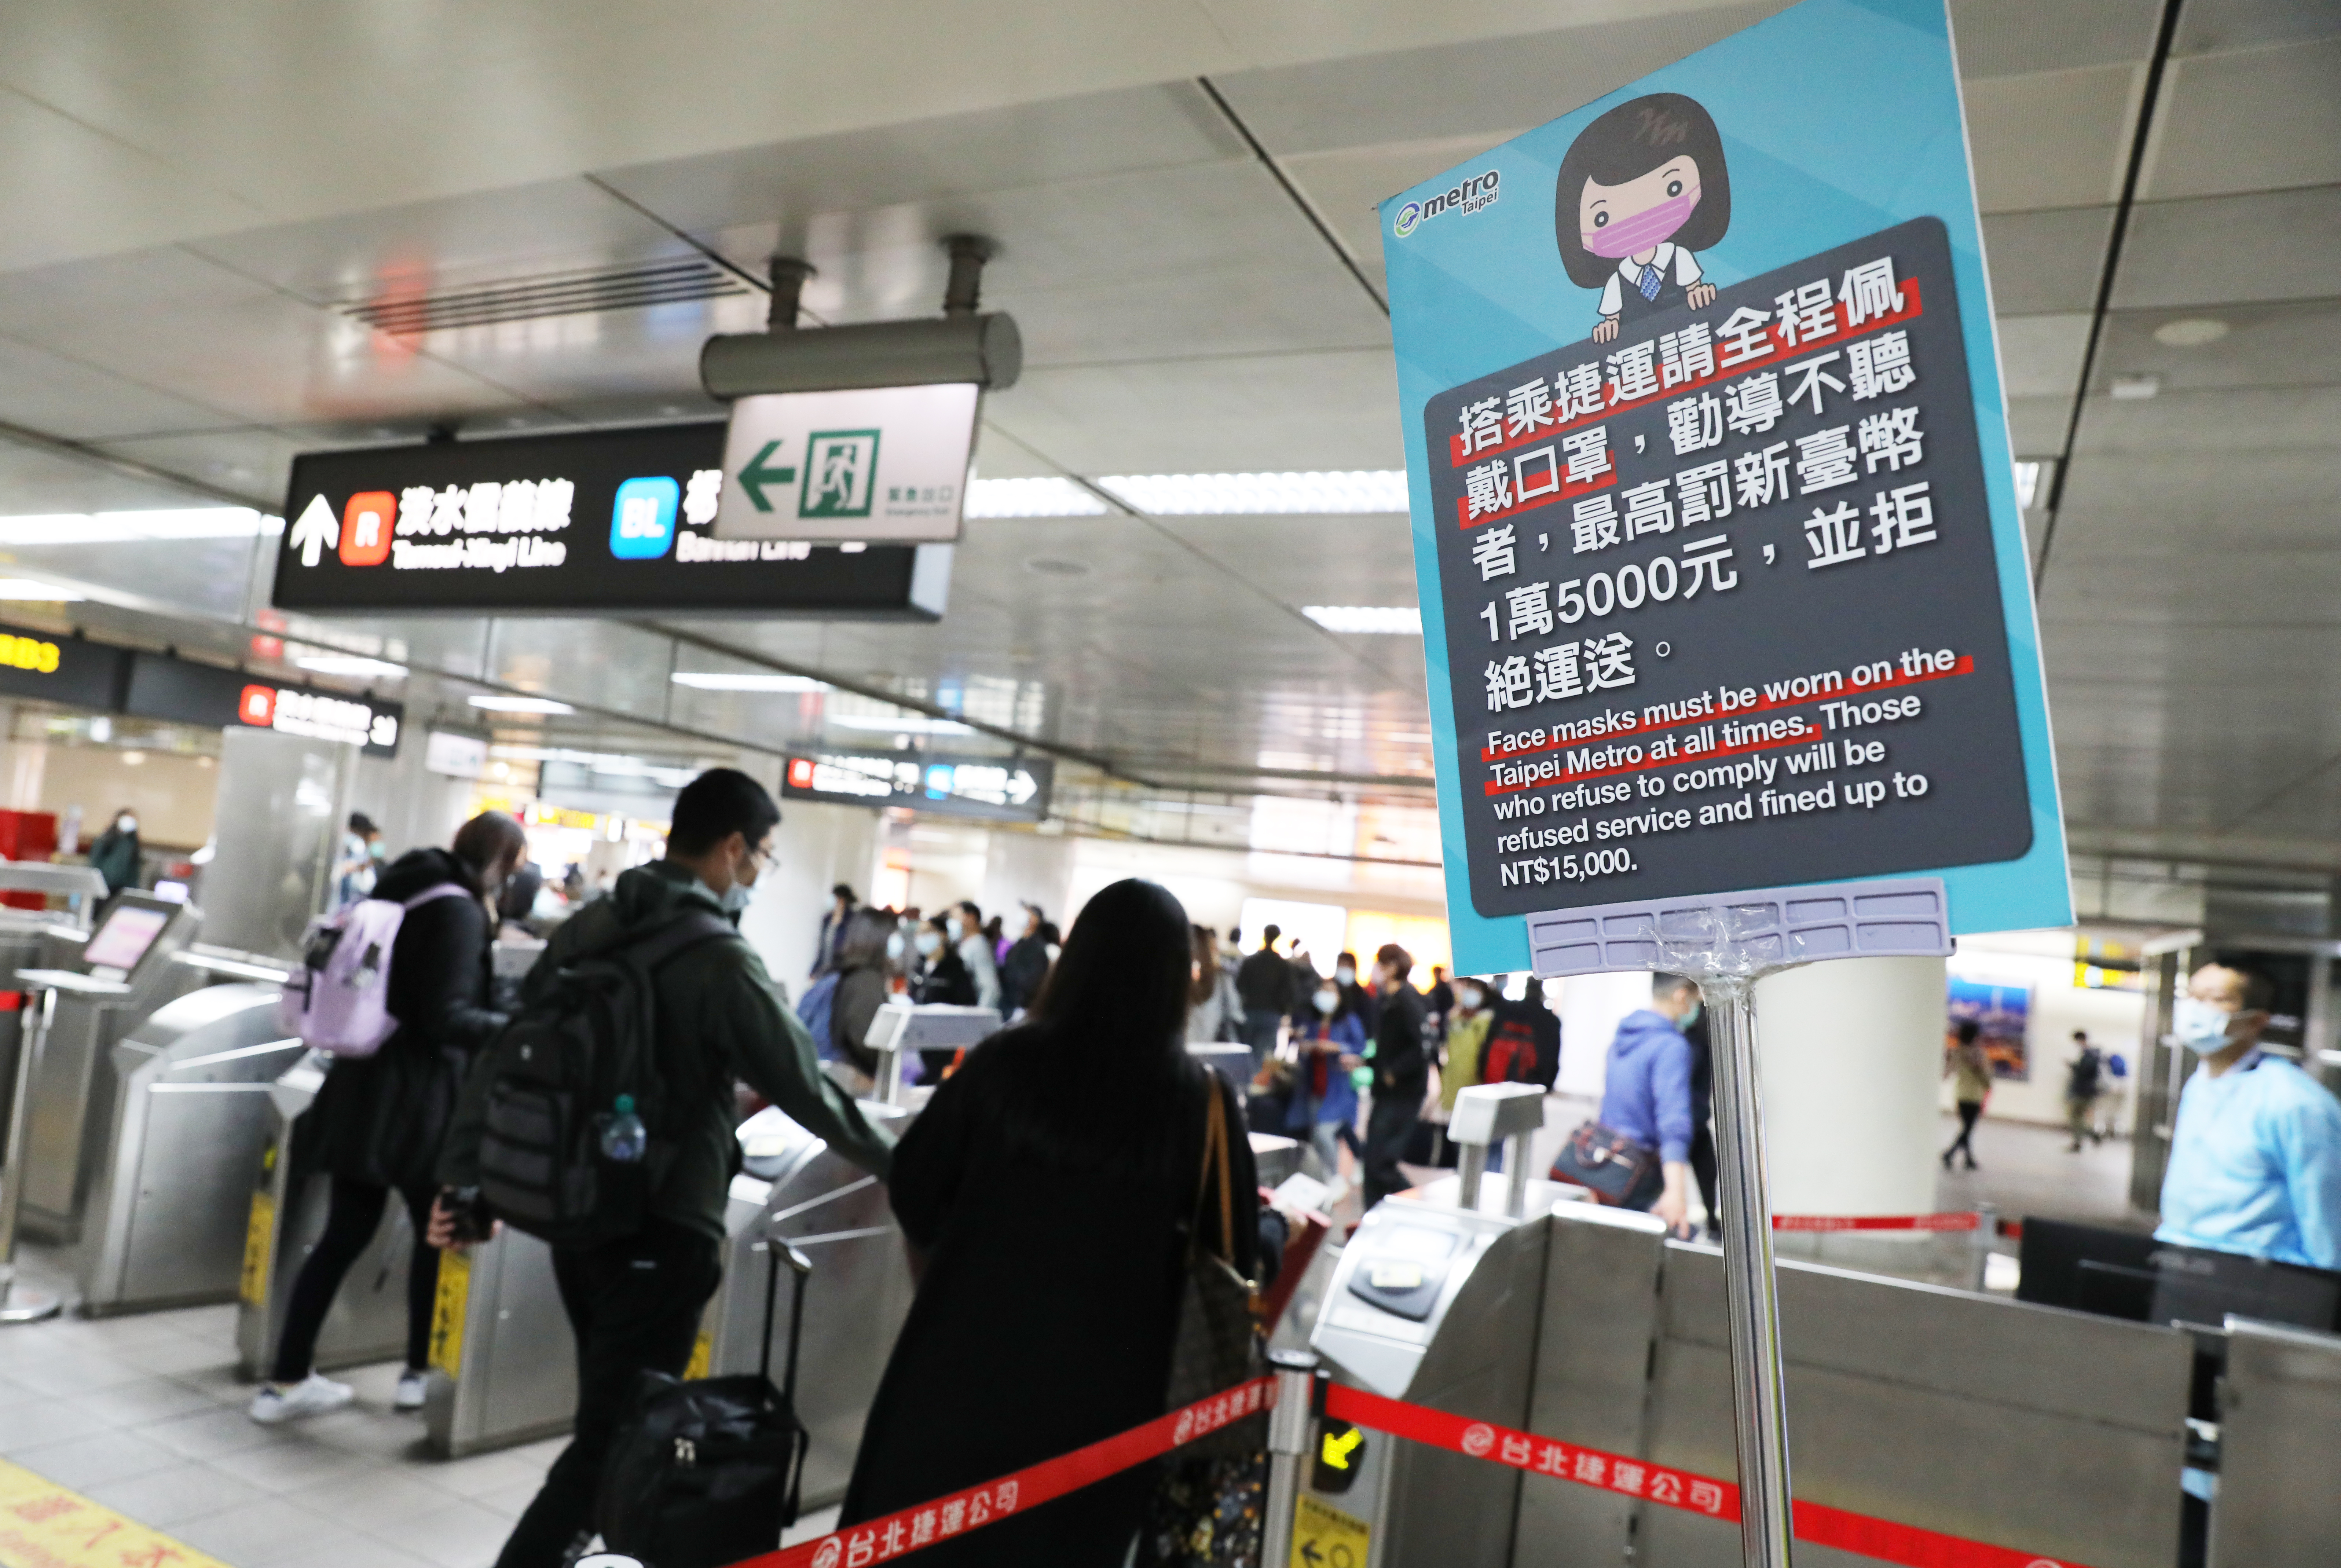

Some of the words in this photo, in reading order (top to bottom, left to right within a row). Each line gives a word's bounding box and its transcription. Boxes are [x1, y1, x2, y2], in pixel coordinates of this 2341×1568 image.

[1424, 171, 1498, 219] metro
[1462, 188, 1497, 214] Taipei
[1459, 256, 1904, 456] 搭乘捷運請全程佩
[1466, 330, 1916, 520] 戴口罩，勸導不聽
[620, 498, 665, 538] BL
[1473, 407, 1923, 581] 者，最高罰新臺幣
[1480, 482, 1937, 641] 1萬5000元，並拒
[1488, 729, 1545, 754] Face
[1553, 709, 1636, 742] masks
[1644, 691, 1714, 725] must
[1720, 686, 1756, 711] be
[1763, 671, 1842, 701] worn
[1852, 661, 1892, 685] on
[1899, 648, 1955, 677] the
[1490, 754, 1560, 787] Taipei
[1567, 745, 1642, 774] Metro
[1651, 734, 1677, 759] at
[1685, 725, 1715, 754] all
[1722, 716, 1813, 747] times.
[1819, 696, 1920, 729] Those
[1494, 795, 1545, 820] who
[1552, 783, 1631, 811] refuse
[1637, 775, 1665, 797] to
[1673, 754, 1777, 792] comply
[1785, 742, 1836, 774] will
[1844, 739, 1884, 765] be
[1498, 818, 1589, 853] refused
[1596, 807, 1691, 839] service
[1699, 793, 1752, 825] and
[1759, 781, 1836, 816] fined
[1844, 781, 1885, 808] up
[1893, 772, 1927, 797] to
[1501, 848, 1637, 886] NT$15,000.
[1501, 1435, 1722, 1513] 台北捷運公司
[846, 1480, 1019, 1568] 台北捷運公司
